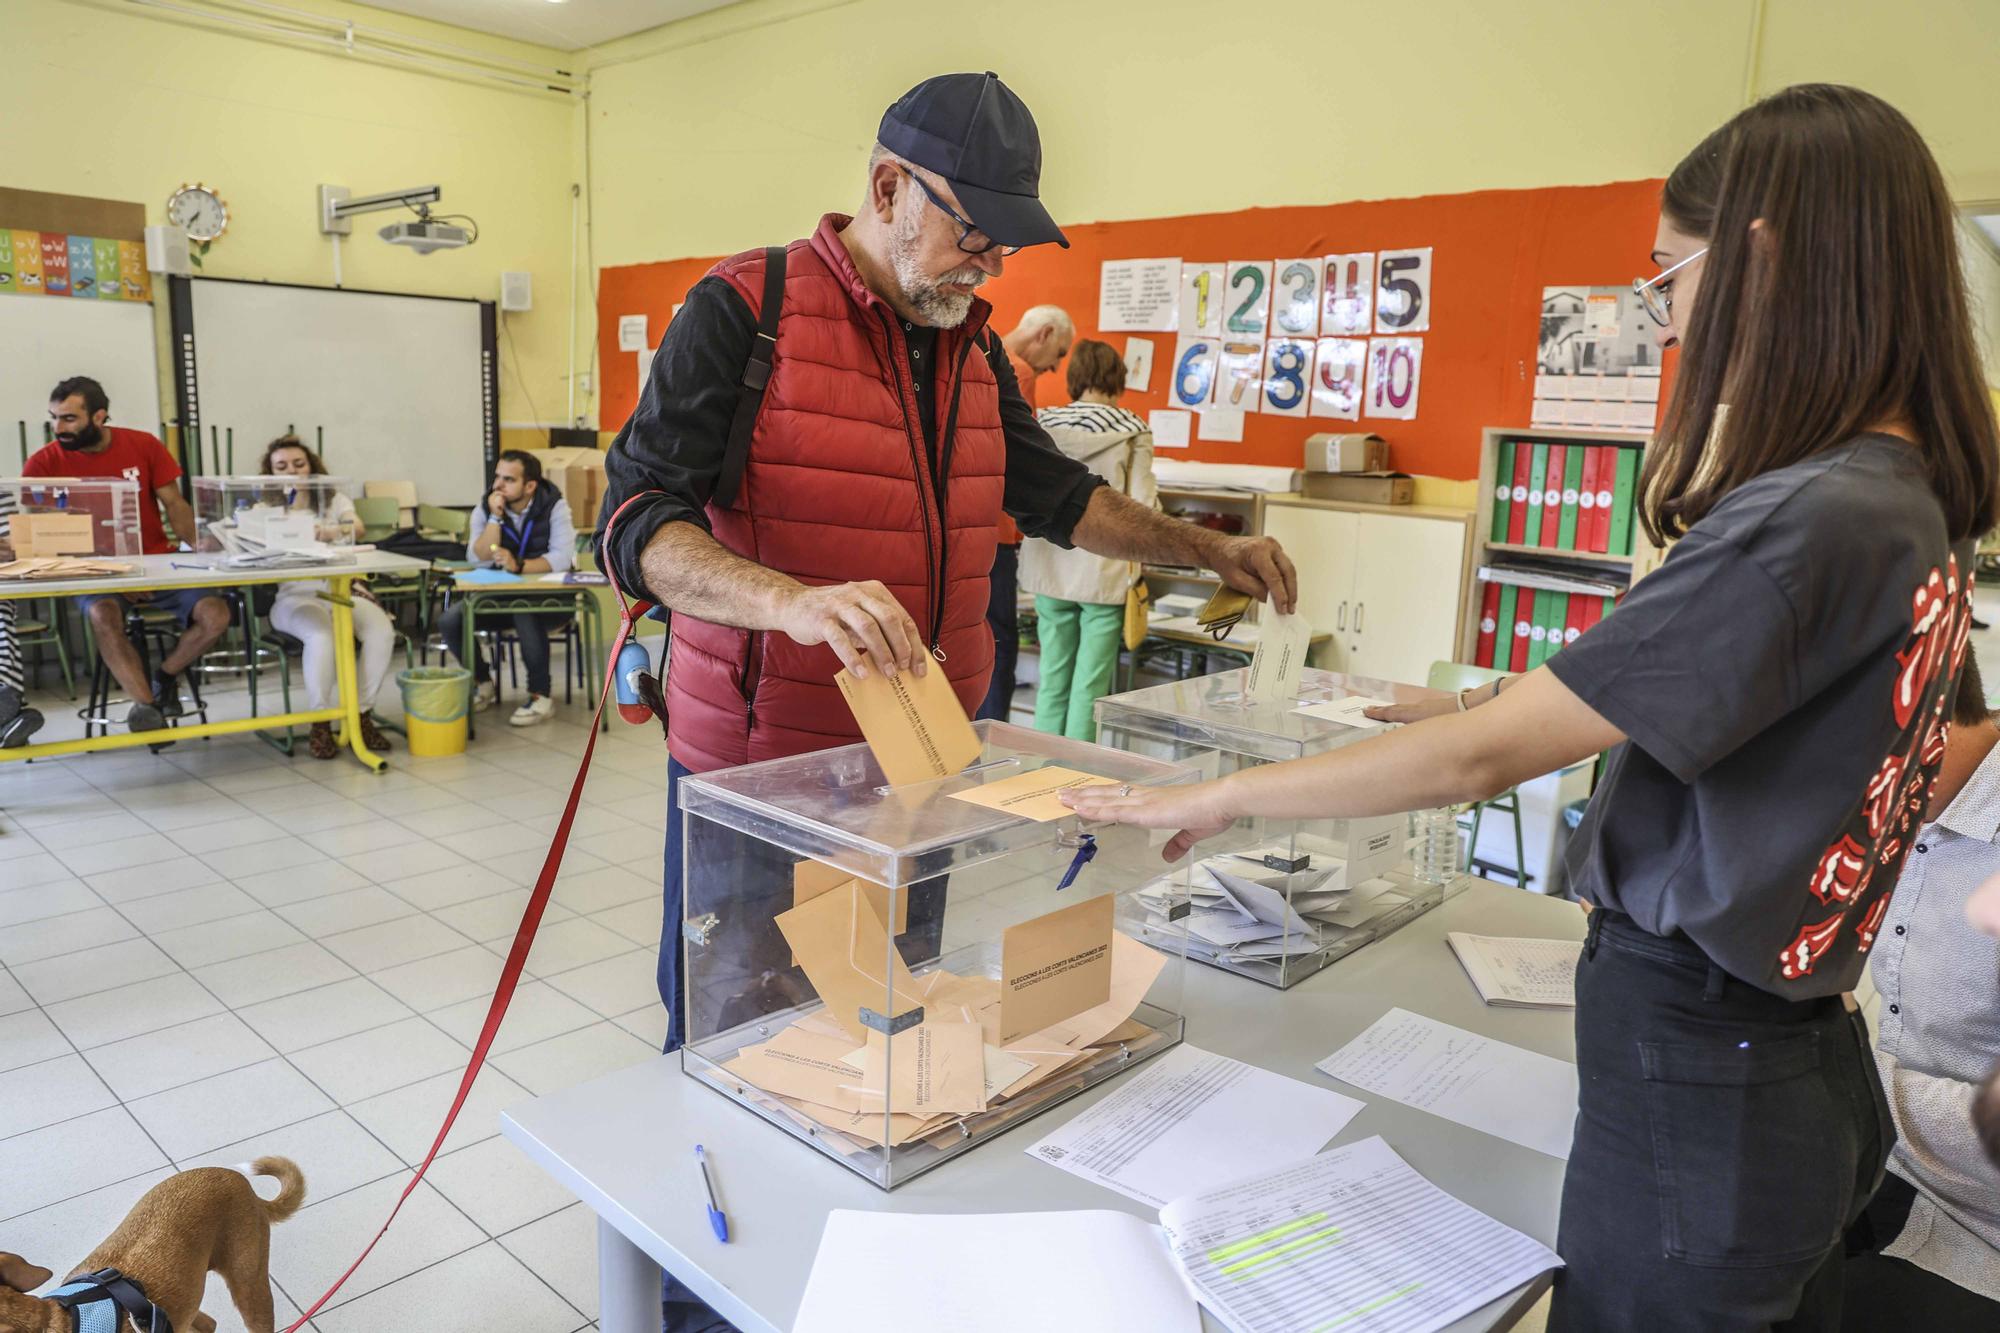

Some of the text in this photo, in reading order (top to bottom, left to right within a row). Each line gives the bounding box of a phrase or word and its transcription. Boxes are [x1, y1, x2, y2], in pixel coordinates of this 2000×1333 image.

[82, 259, 94, 270] X
[1325, 261, 1364, 331] 4
[1378, 257, 1423, 327] 5
[1193, 271, 1211, 328] 1
[1228, 265, 1265, 333] 2
[1277, 262, 1316, 332] 3
[1176, 343, 1211, 405] 6
[1224, 342, 1261, 405] 7
[1266, 344, 1305, 410] 8
[1321, 340, 1357, 412] 9
[1376, 345, 1415, 409] 10
[1011, 971, 1038, 986] ELECCIONS
[1042, 966, 1052, 974] LES
[1052, 960, 1067, 970] CORTS
[1068, 948, 1097, 964] VALENCIANES
[1098, 944, 1107, 953] 2023
[1014, 976, 1041, 991] ELECCIONES
[1054, 967, 1068, 976] CORTS
[1069, 956, 1095, 970] VALENCIANES
